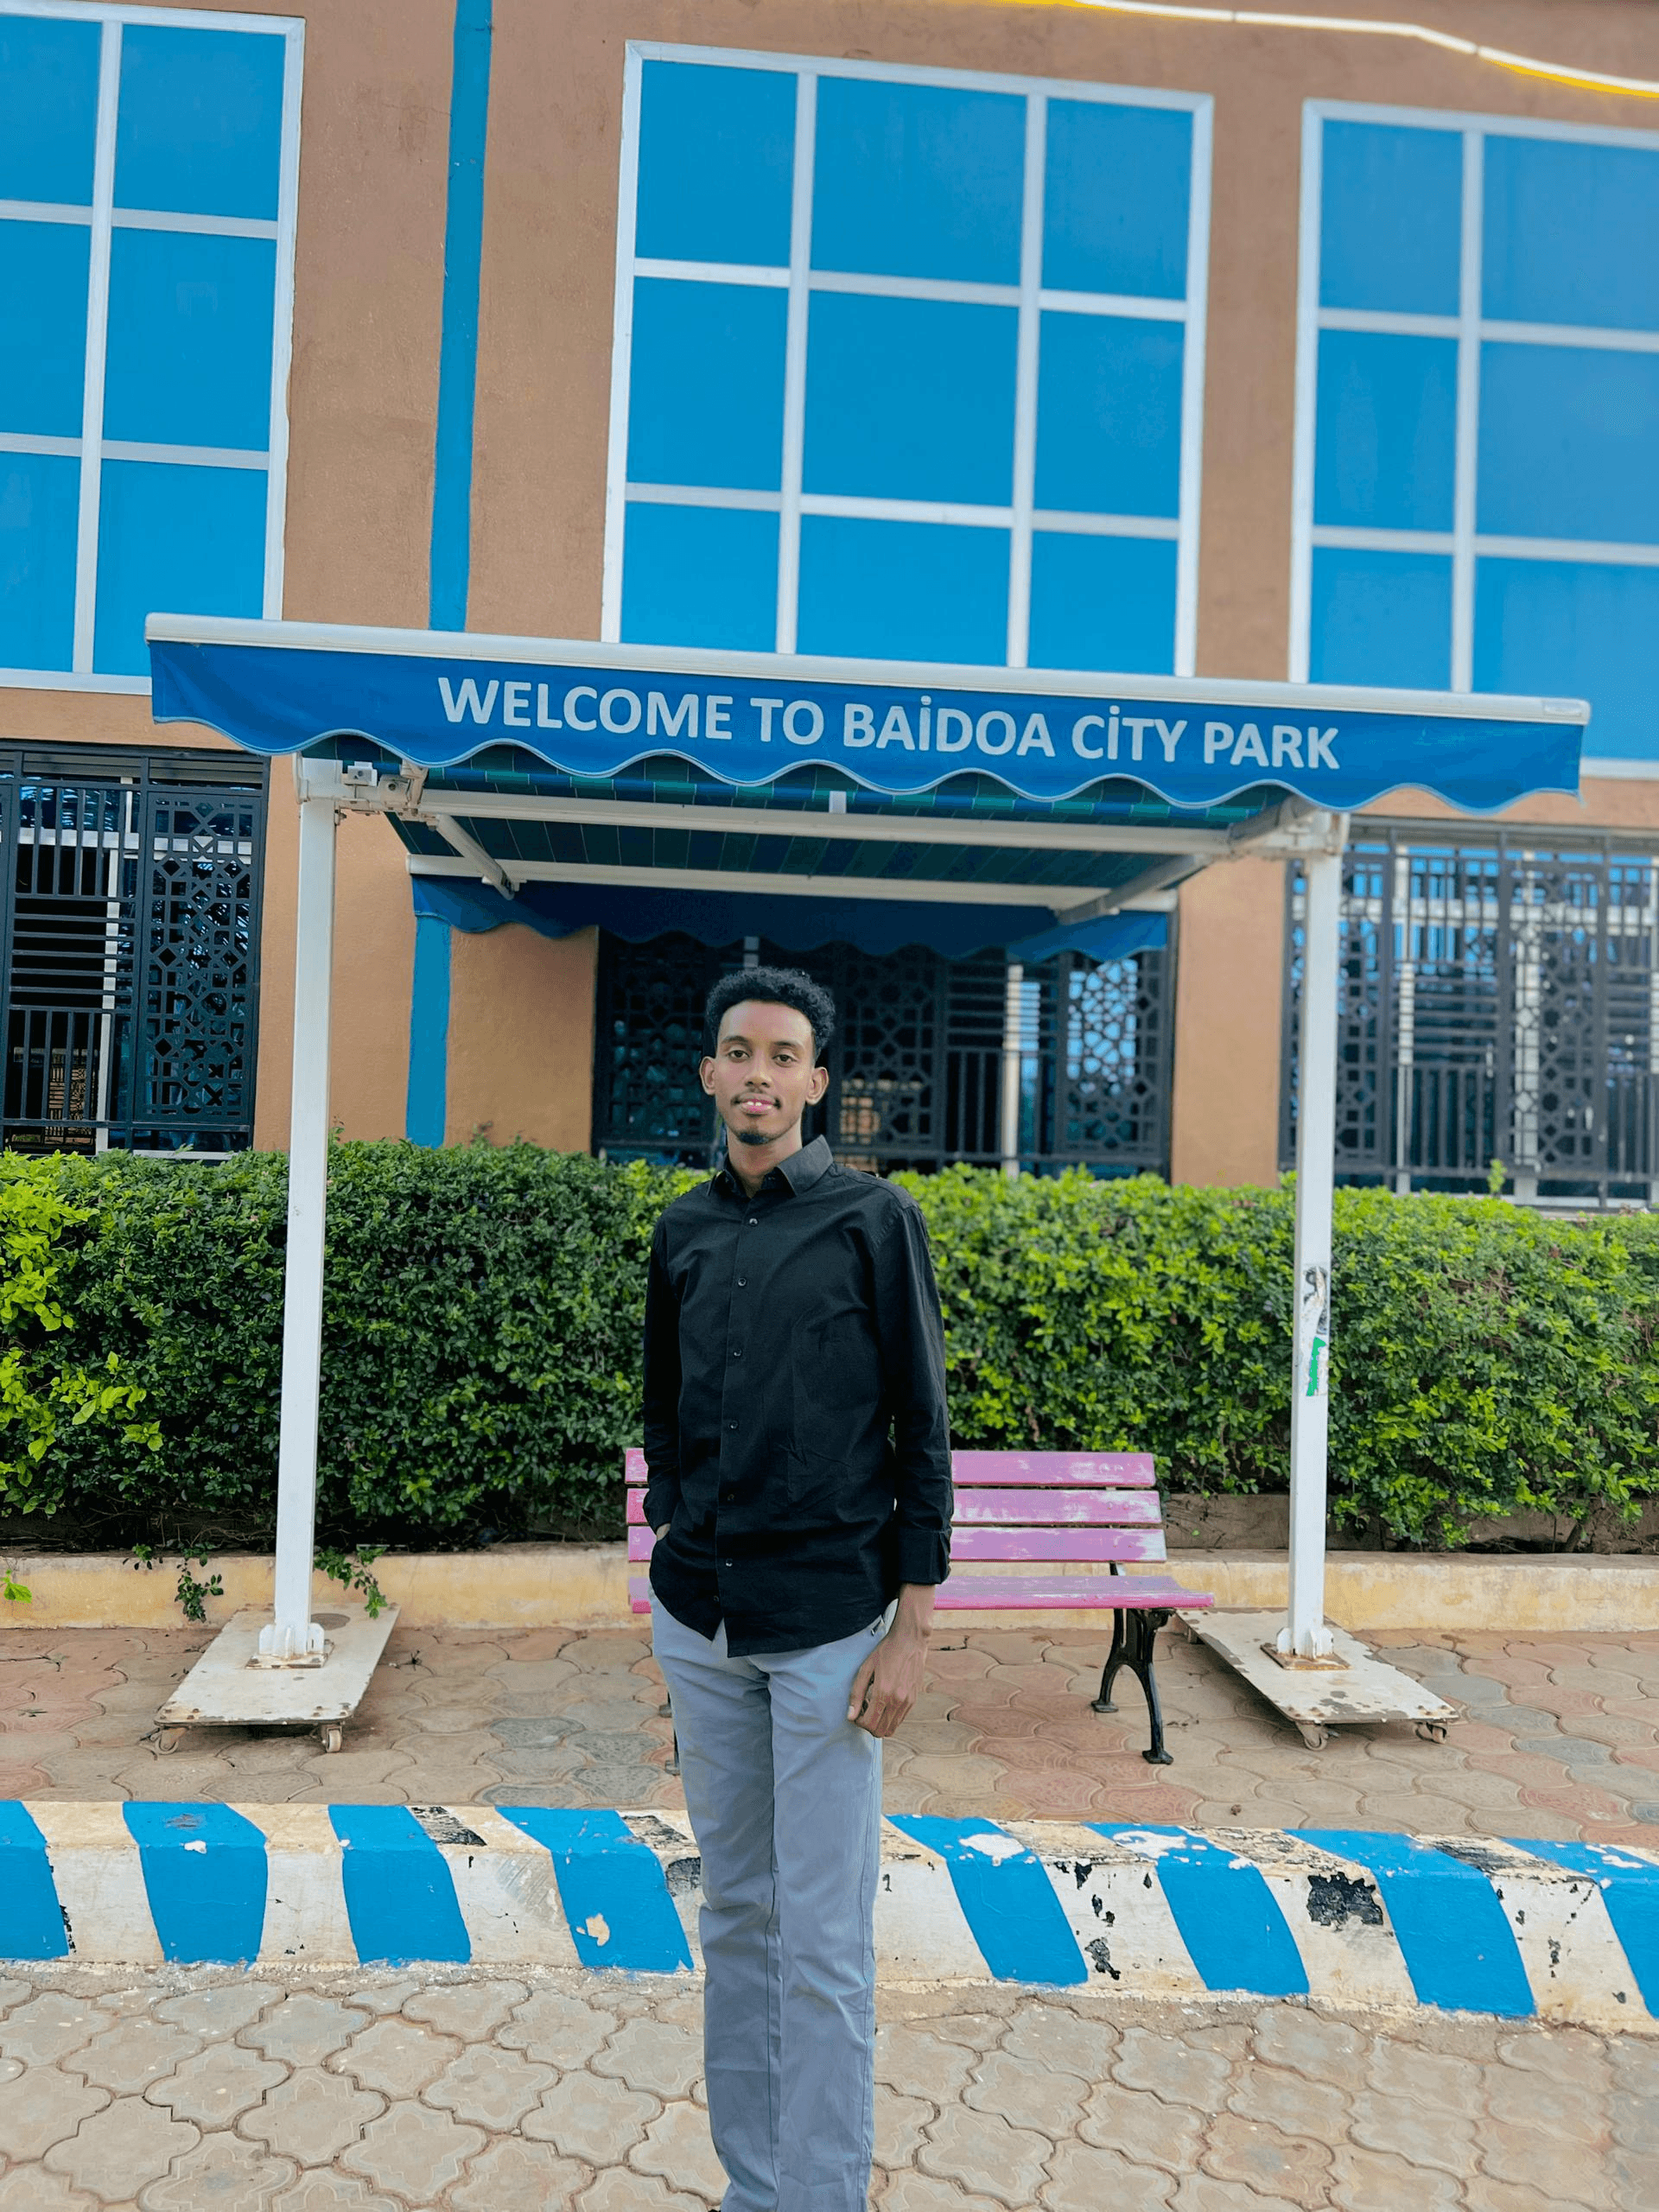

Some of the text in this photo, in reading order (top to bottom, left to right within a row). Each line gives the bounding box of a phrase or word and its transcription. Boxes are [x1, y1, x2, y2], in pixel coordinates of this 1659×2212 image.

[438, 677, 734, 740] WELCOME
[750, 697, 823, 745] TO
[1205, 721, 1339, 769] PARK
